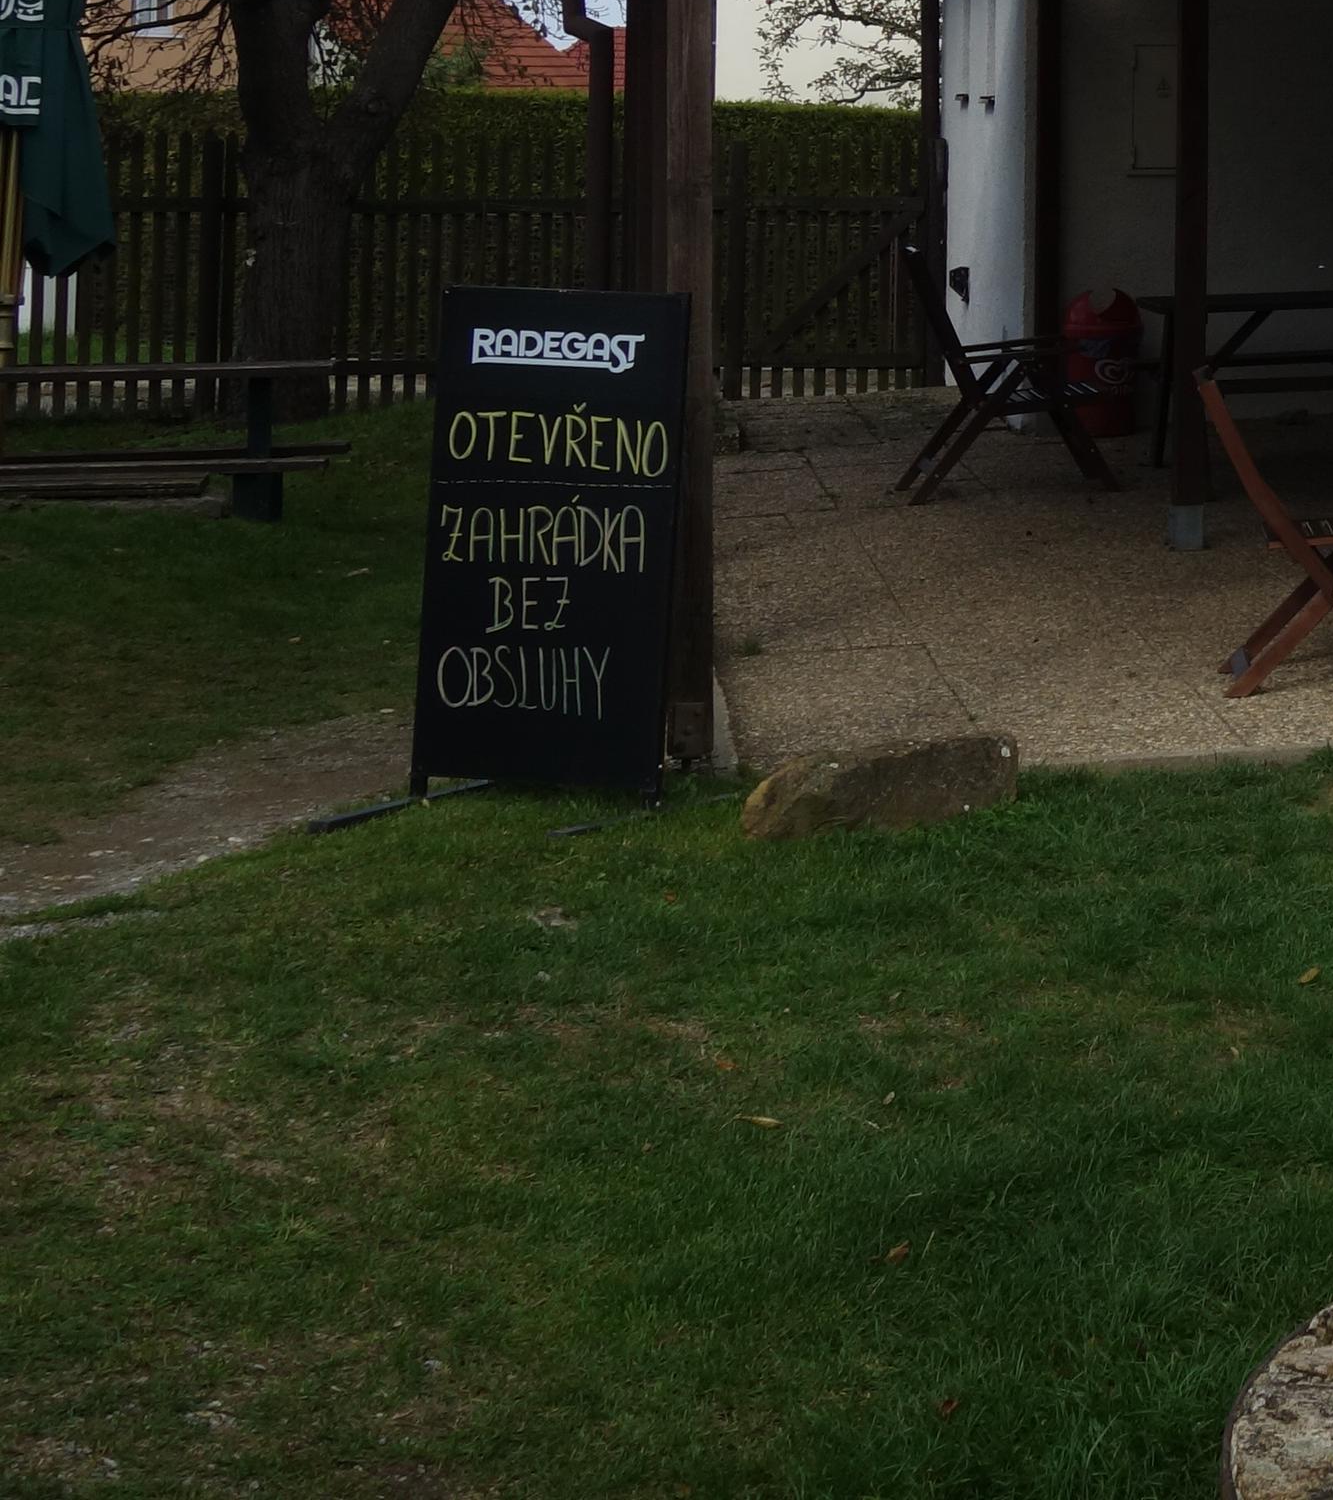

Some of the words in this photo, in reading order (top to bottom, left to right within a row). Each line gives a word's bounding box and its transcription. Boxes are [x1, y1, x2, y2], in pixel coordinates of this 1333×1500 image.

[471, 328, 646, 373] RADEGAST
[449, 402, 669, 477] OTEVŘENO
[440, 495, 646, 573] ZAHRÁDKA
[485, 576, 571, 634] BEZ
[437, 645, 610, 720] OBSLUHY
